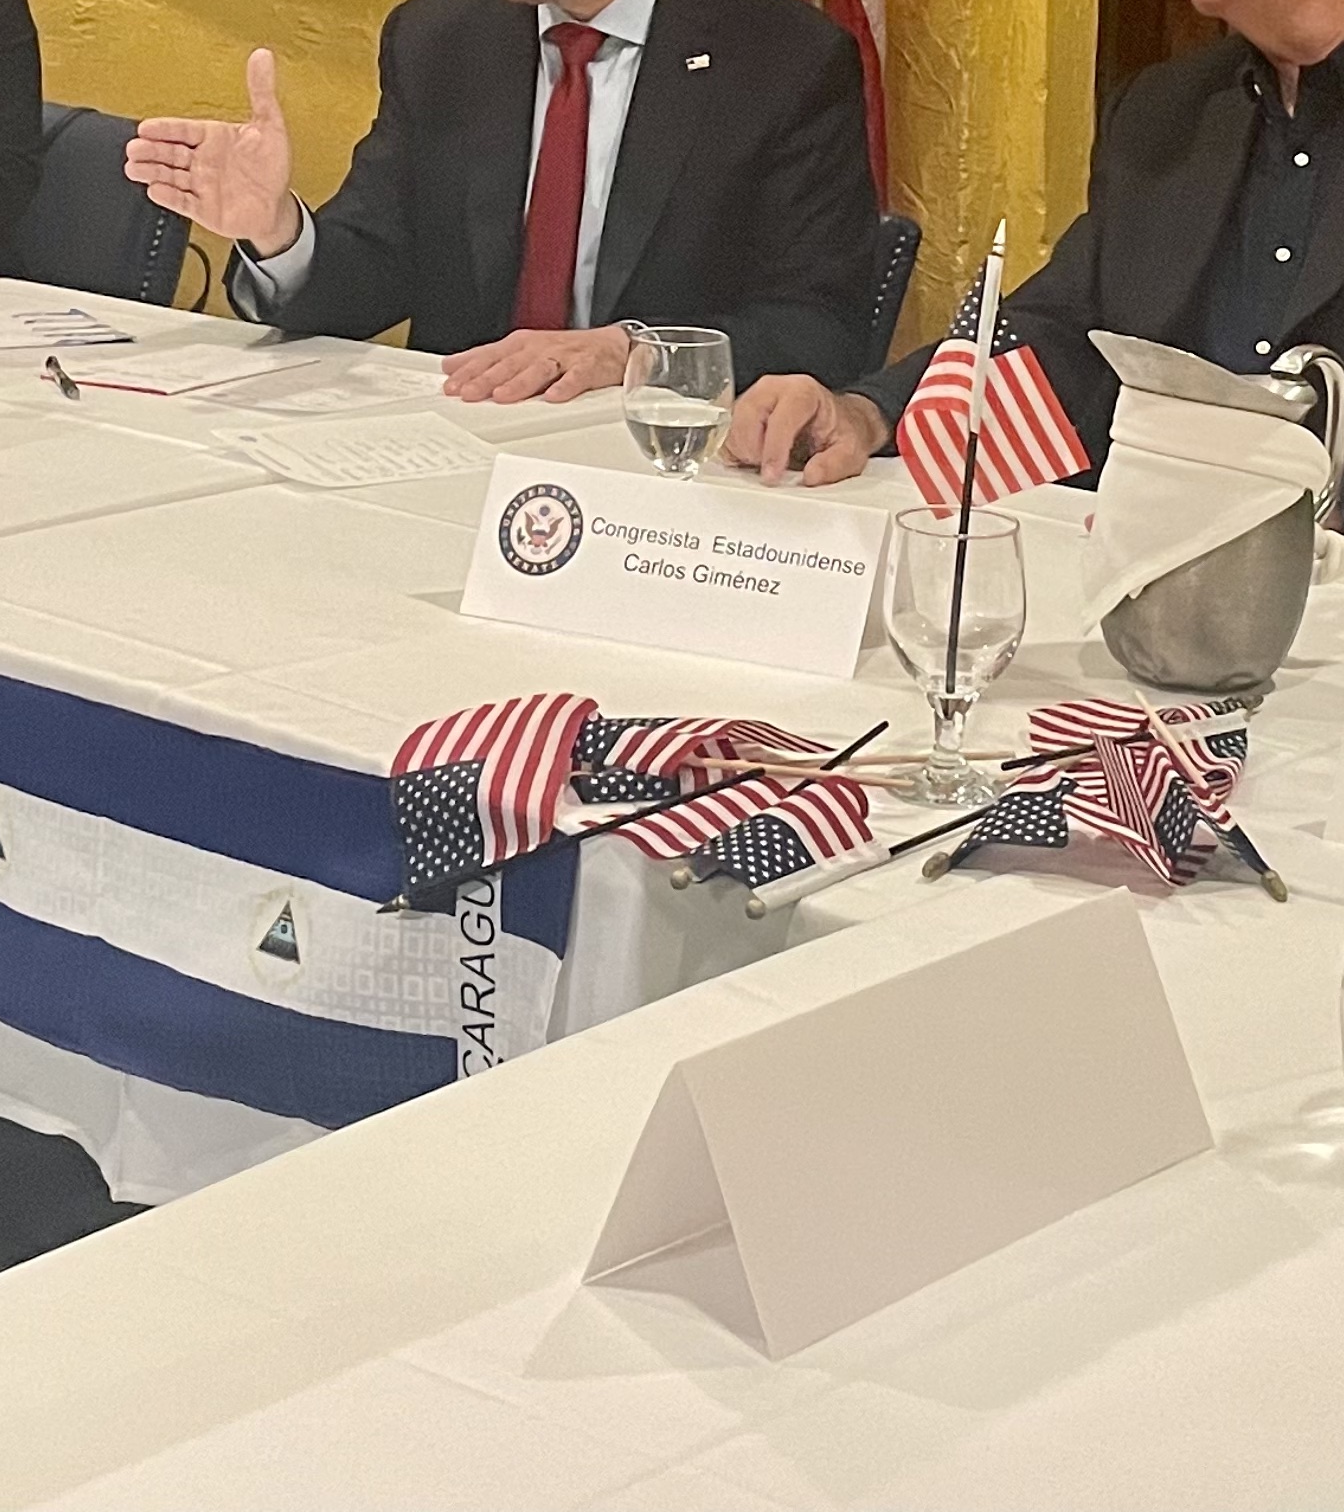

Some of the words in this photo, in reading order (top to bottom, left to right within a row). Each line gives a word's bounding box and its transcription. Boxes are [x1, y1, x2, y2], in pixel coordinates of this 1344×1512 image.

[591, 516, 700, 550] Congresista
[712, 536, 866, 576] Estadounidense
[623, 553, 686, 580] Carlos
[692, 563, 781, 595] Giménez
